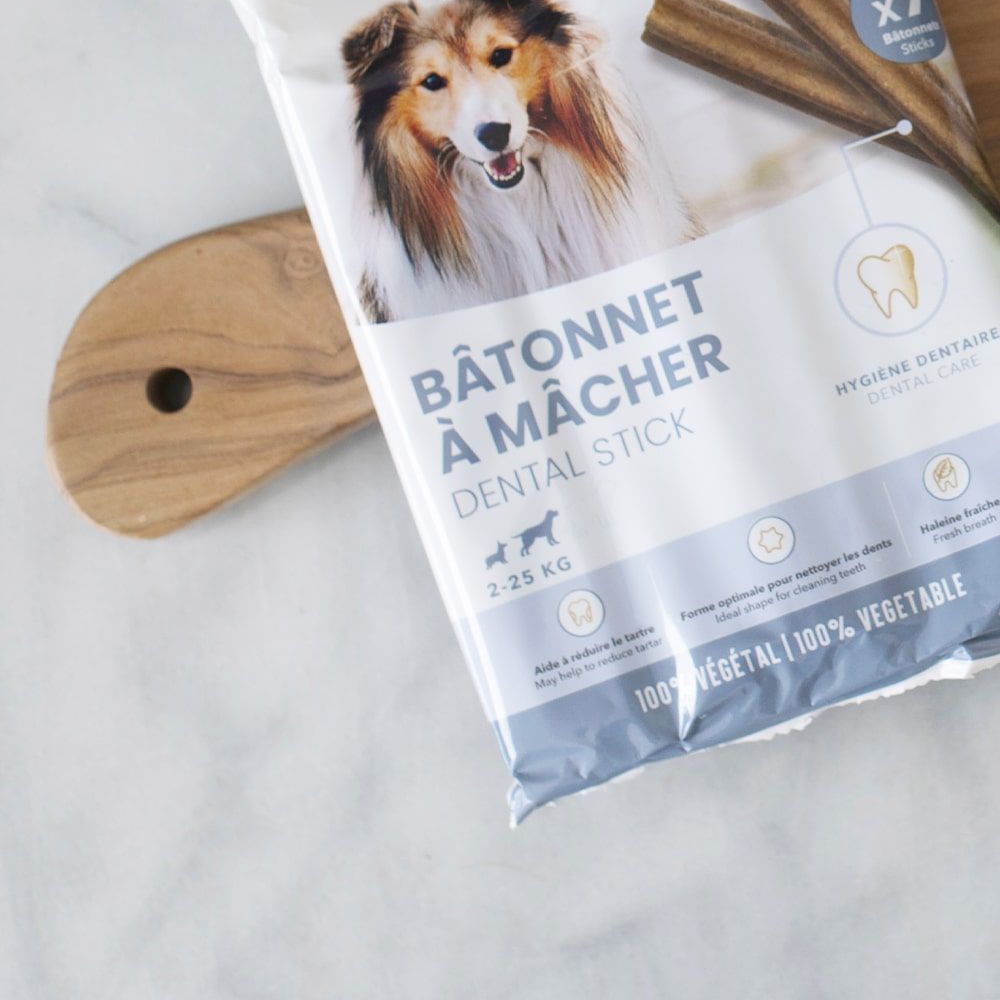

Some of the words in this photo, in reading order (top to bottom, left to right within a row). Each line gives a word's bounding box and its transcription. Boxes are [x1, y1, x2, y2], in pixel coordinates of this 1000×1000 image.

[901, 37, 935, 56] Sticks
[410, 270, 704, 415] BÂTONNET
[835, 360, 912, 396] HYGIÈNE
[915, 327, 1000, 367] DENTAIRE
[437, 417, 481, 474] À
[485, 334, 730, 454] MÂCHER
[867, 374, 934, 405] DENTAL
[937, 354, 982, 379] CARE
[451, 451, 586, 519] DENTAL
[593, 407, 695, 466] STICK
[920, 514, 962, 534] Haleine
[964, 499, 1000, 518] fraîche
[933, 527, 962, 544] Fresh
[963, 513, 997, 533] breath
[487, 569, 534, 598] 2-25
[541, 556, 571, 578] KG
[680, 603, 716, 621] Forme
[718, 584, 765, 609] optimale
[767, 576, 793, 594] pour
[794, 558, 842, 580] nettoyer
[843, 550, 860, 563] les
[861, 537, 893, 556] dents
[715, 608, 742, 624] Ideal
[744, 596, 774, 615] shape
[776, 590, 791, 602] for
[793, 572, 837, 596] cleaning
[839, 562, 867, 580] teeth
[534, 661, 560, 676] Aide
[561, 656, 569, 665] à
[571, 641, 610, 662] réduire
[611, 637, 623, 647] le
[624, 626, 655, 641] tartre
[693, 641, 782, 691] VÉGÉTAL
[793, 616, 855, 656] 100%
[856, 572, 968, 632] VEGETABLE
[535, 676, 558, 690] May
[560, 666, 583, 681] help
[584, 661, 595, 671] to
[597, 648, 633, 666] reduce
[635, 638, 663, 654] tartar
